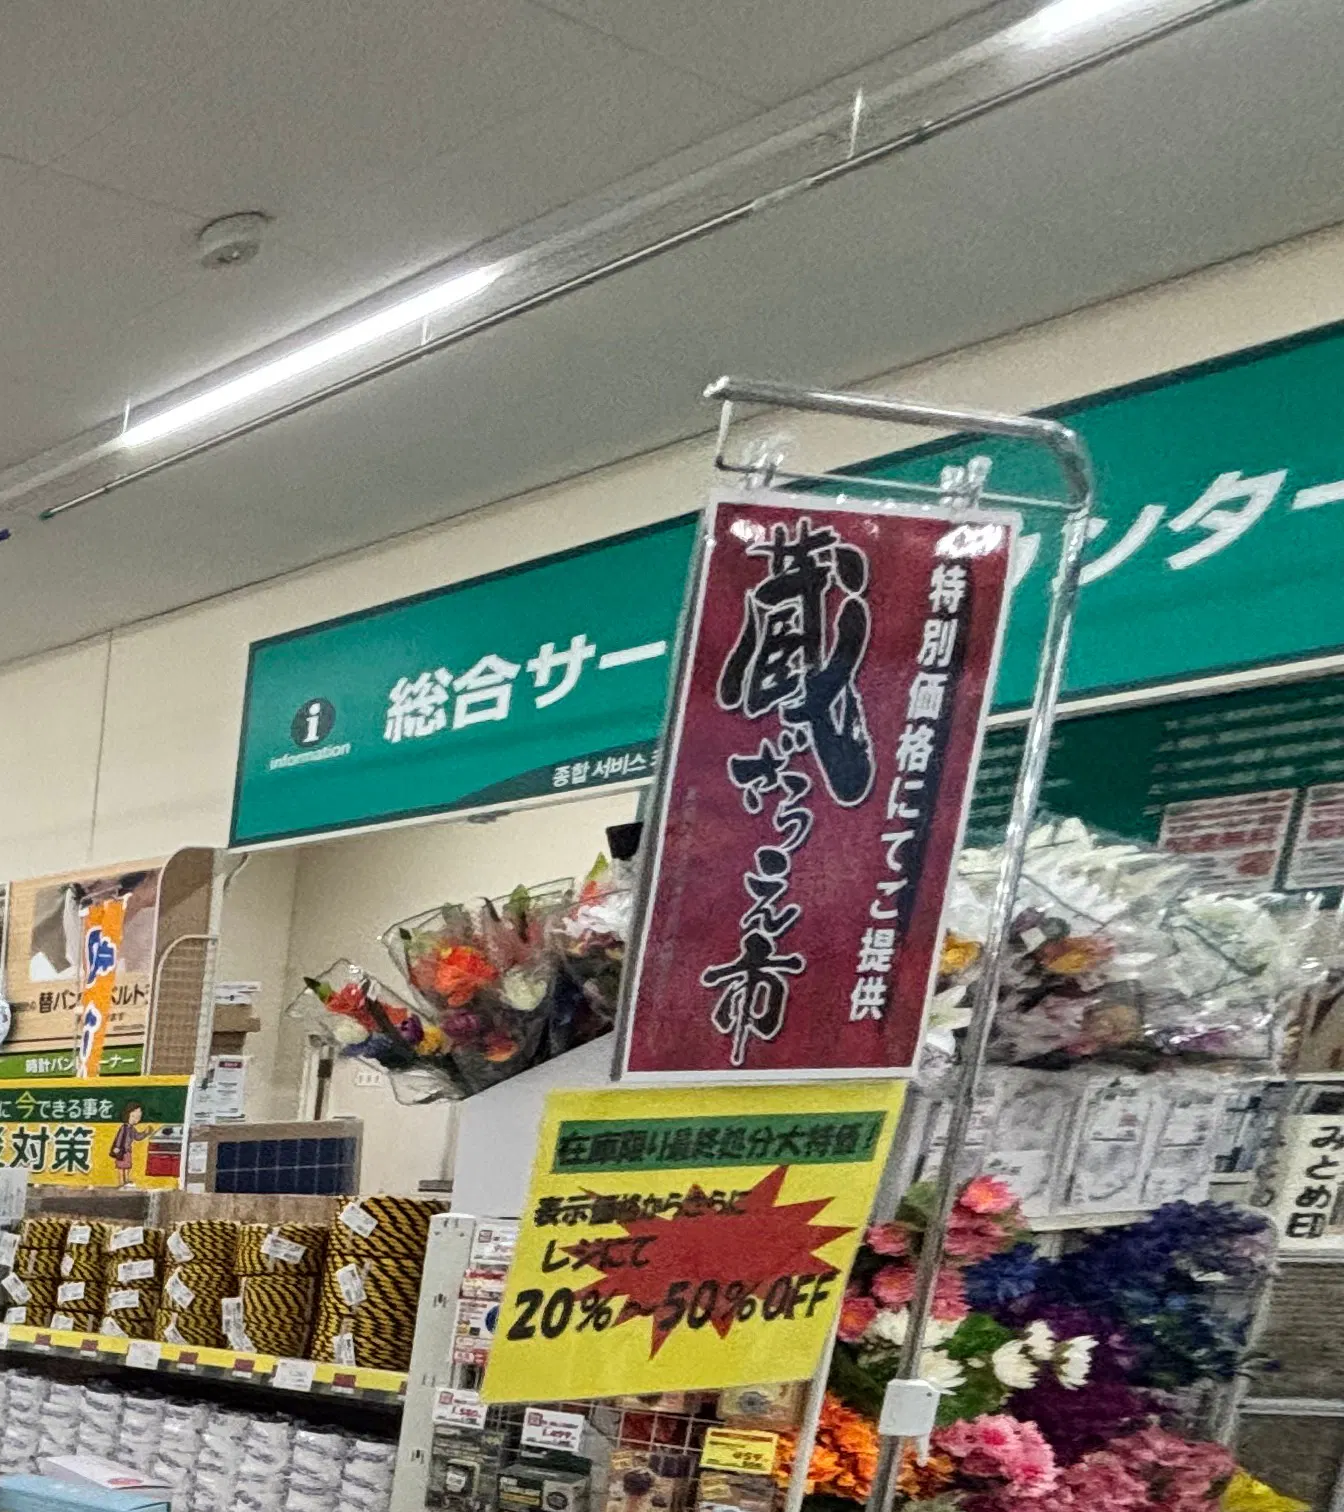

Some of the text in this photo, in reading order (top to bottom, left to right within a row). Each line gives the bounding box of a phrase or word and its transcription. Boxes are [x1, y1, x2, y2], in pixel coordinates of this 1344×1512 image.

[384, 634, 667, 742] 総合サー
[269, 743, 351, 771] information
[849, 565, 969, 1021] 特別価格にてご提供
[1287, 1124, 1344, 1238] みとめ印
